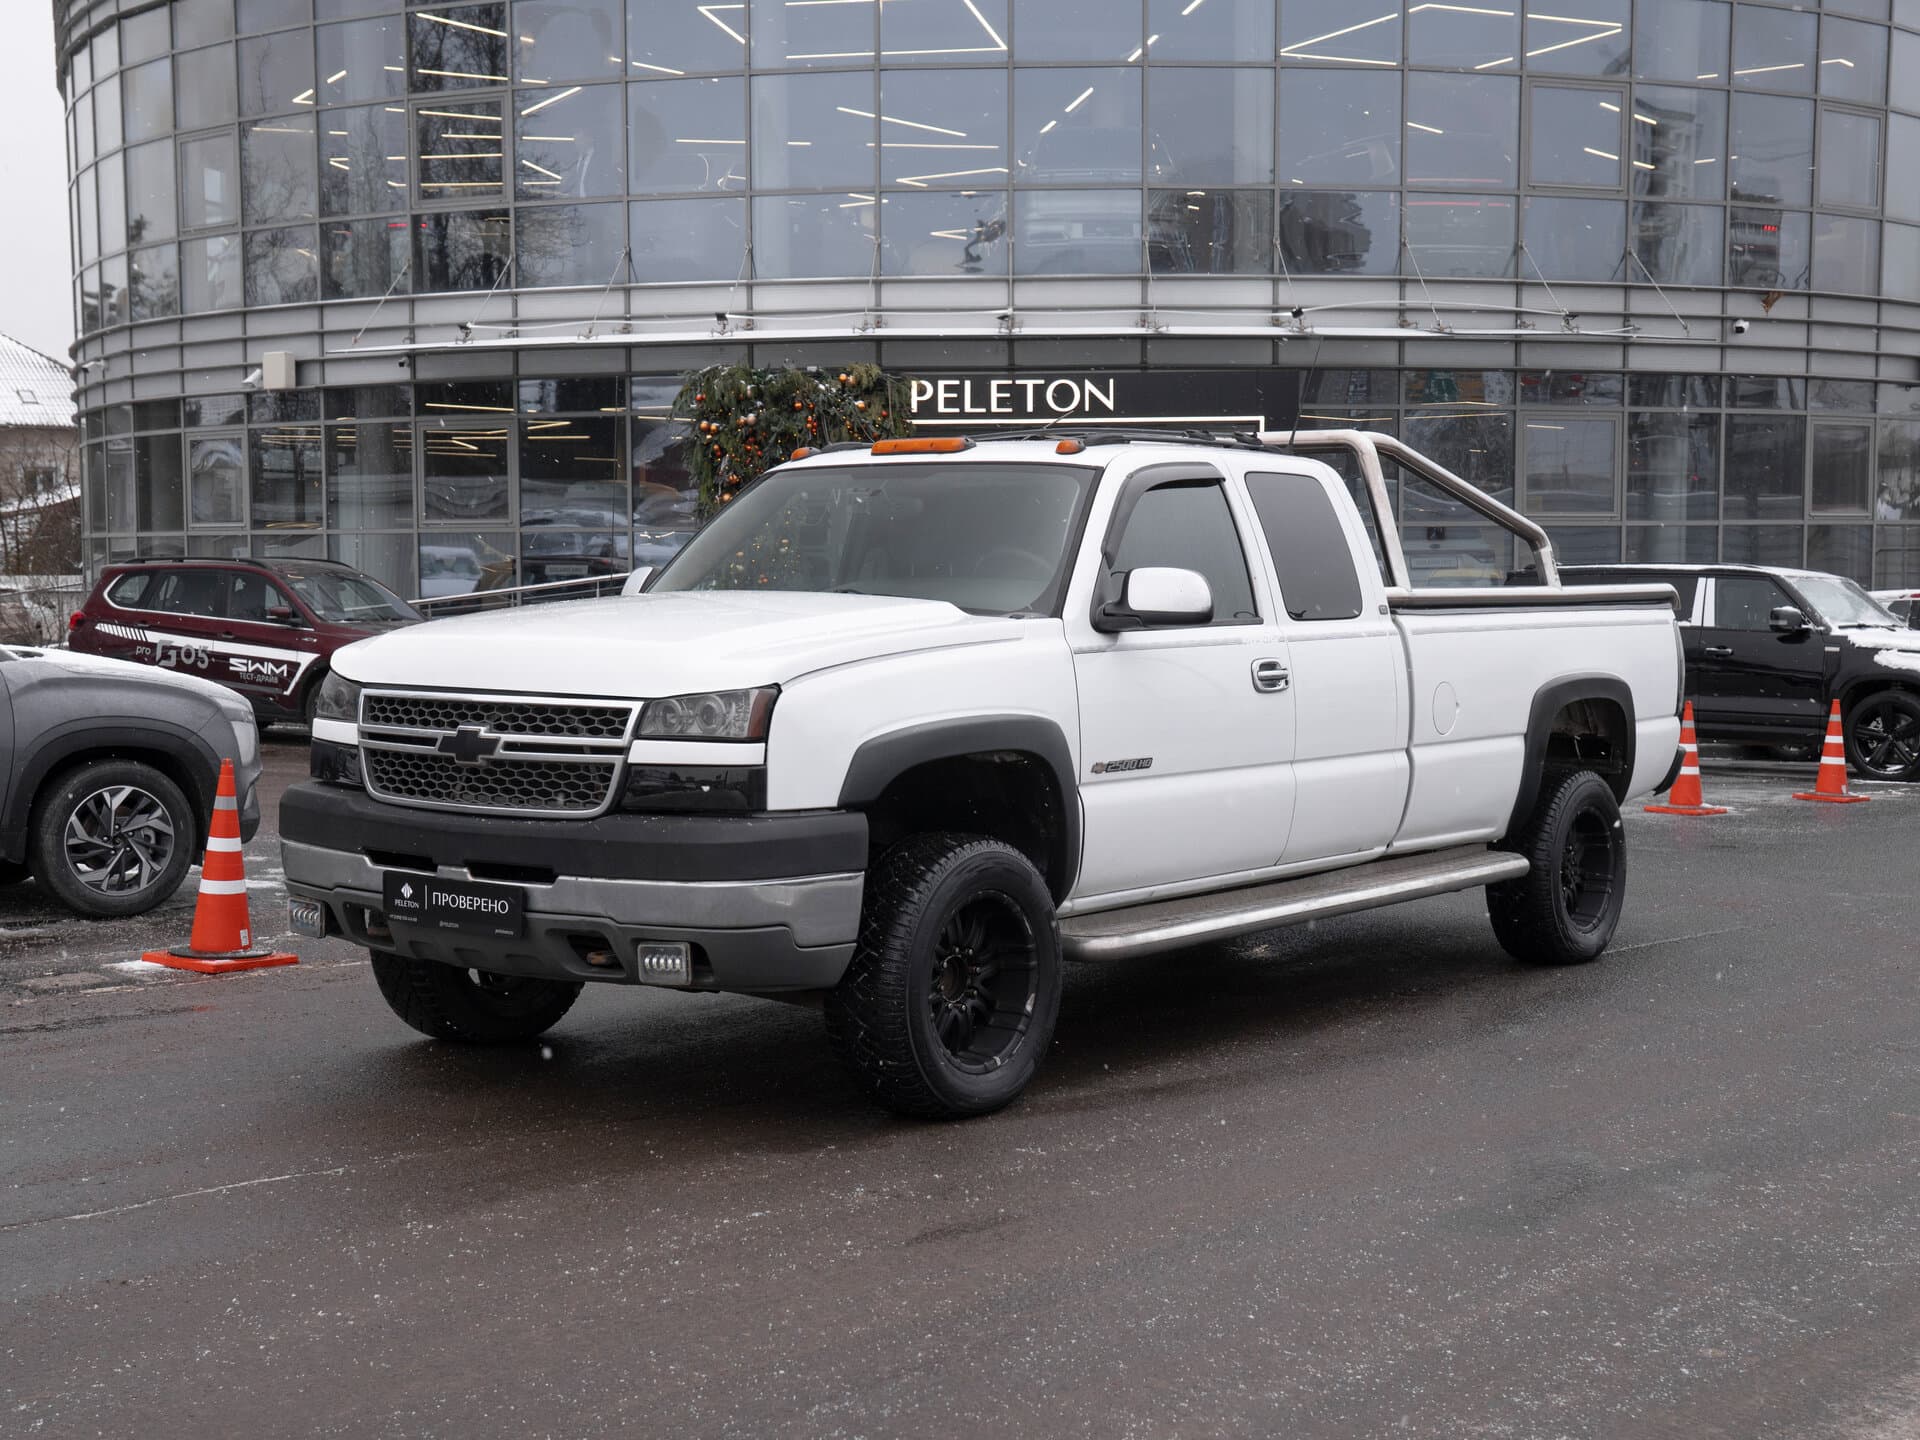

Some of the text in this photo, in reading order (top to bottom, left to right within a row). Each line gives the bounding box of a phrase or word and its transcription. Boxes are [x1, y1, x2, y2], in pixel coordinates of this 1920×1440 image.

[910, 378, 1115, 413] PELETON
[136, 645, 151, 655] pro
[229, 657, 288, 677] SWM
[394, 898, 420, 909] PELETON
[432, 891, 509, 914] ПРОВЕРЕНО
